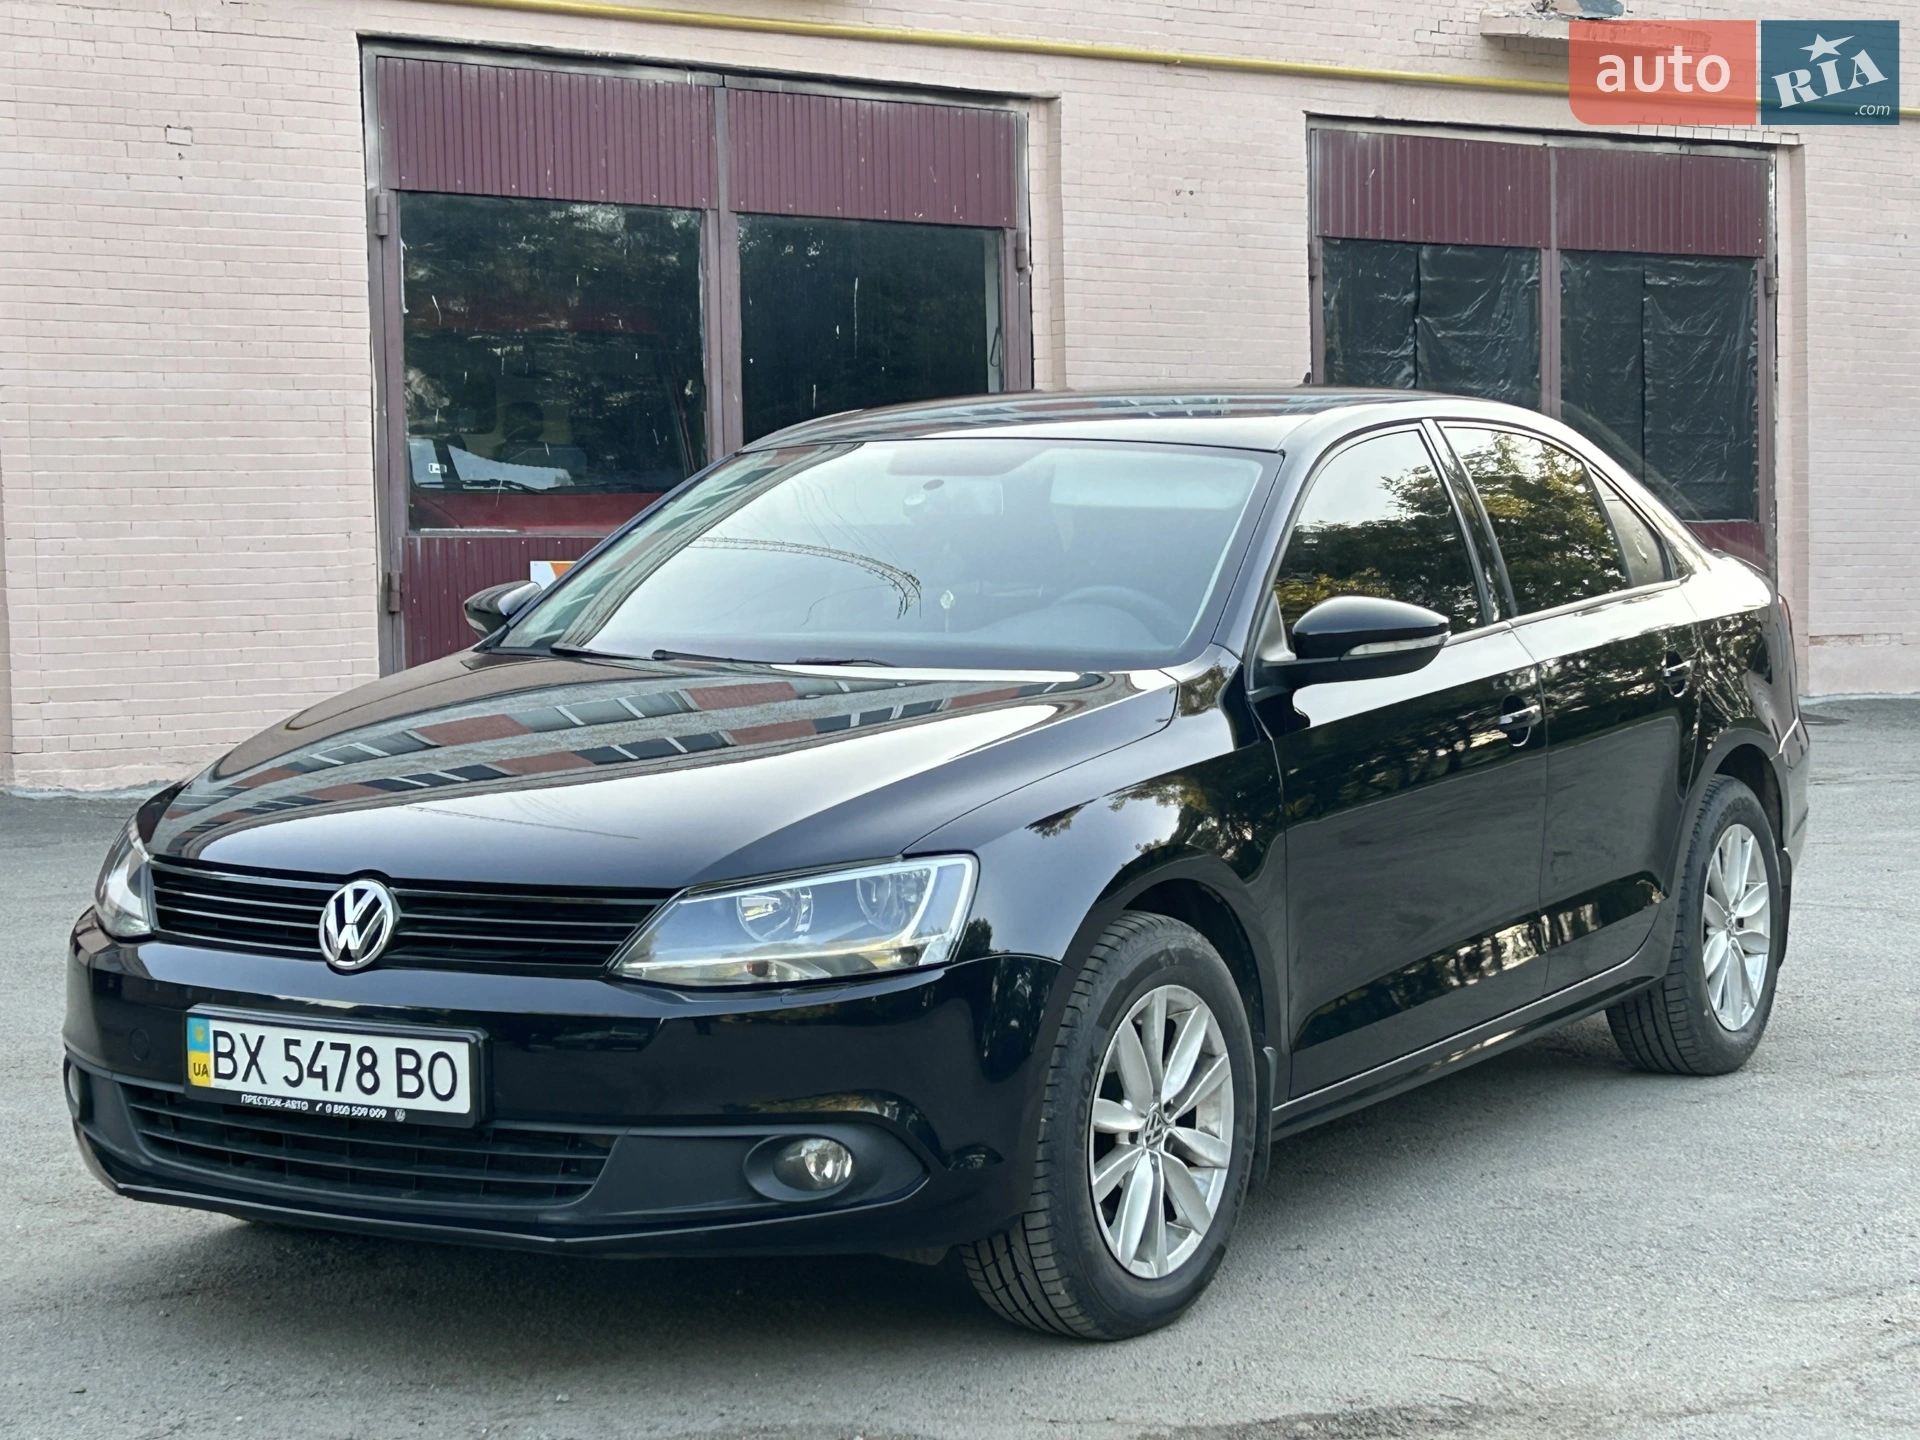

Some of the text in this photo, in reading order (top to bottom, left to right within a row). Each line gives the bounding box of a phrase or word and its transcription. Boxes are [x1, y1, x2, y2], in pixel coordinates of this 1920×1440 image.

[193, 1062, 210, 1078] UA
[213, 1029, 458, 1102] BX 5478 BO
